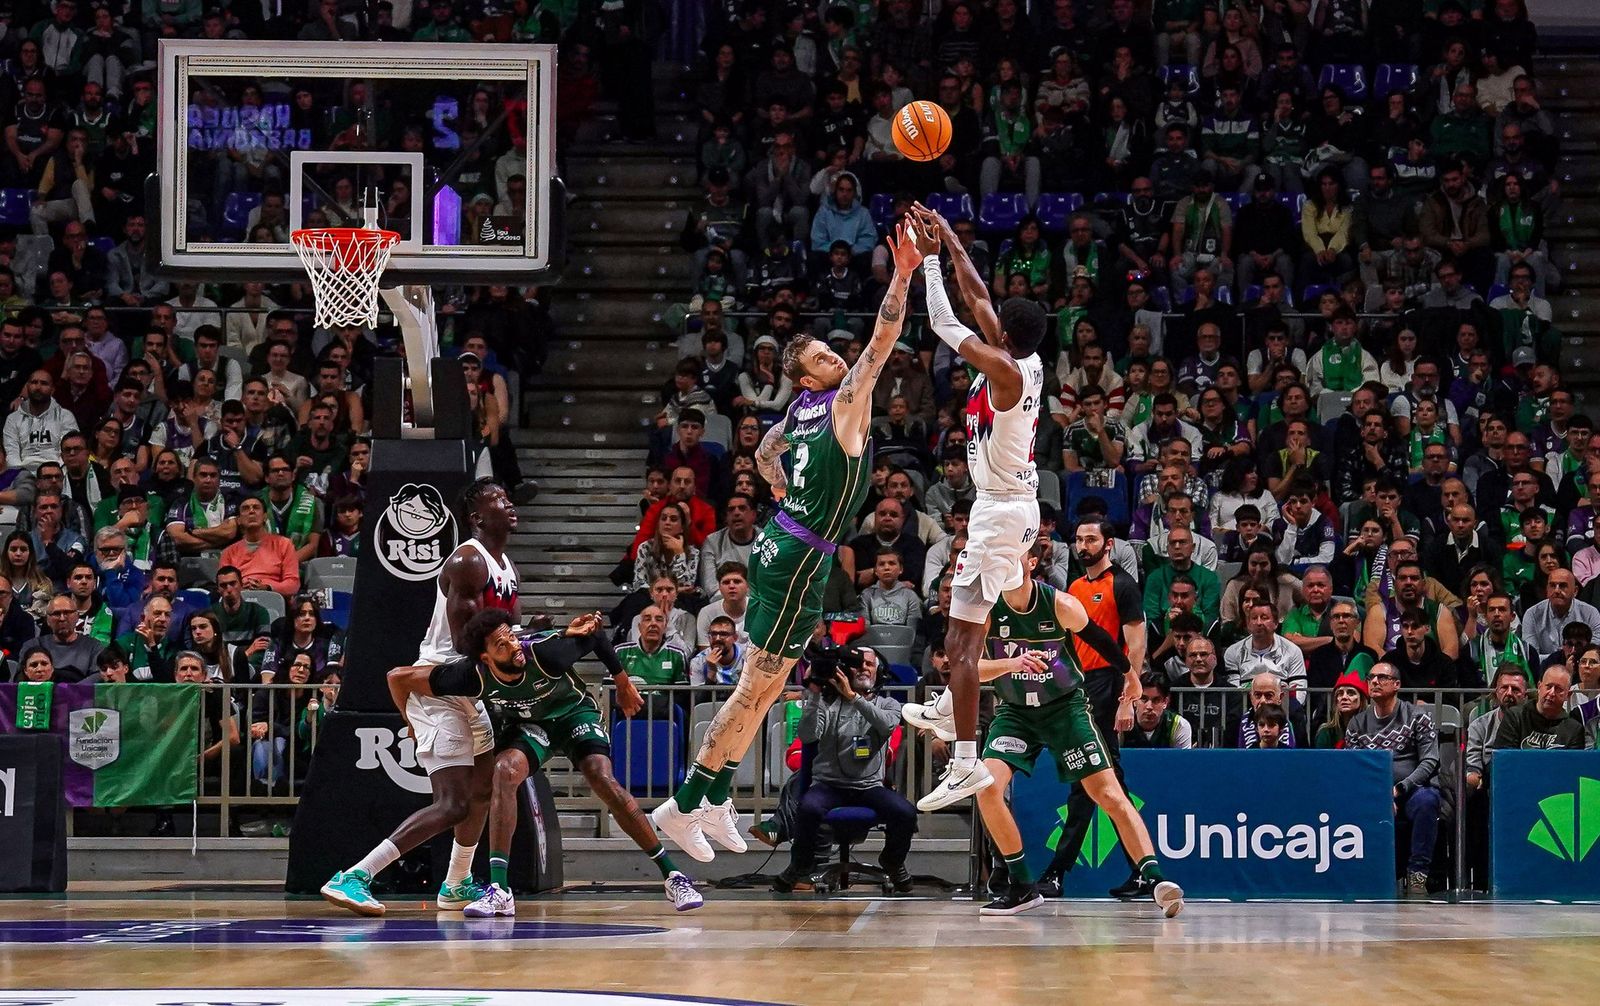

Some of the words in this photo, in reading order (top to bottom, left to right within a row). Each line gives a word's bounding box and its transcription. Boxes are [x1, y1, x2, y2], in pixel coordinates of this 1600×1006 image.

[29, 430, 52, 443] HH
[793, 442, 809, 489] 2
[387, 539, 444, 573] Risi
[81, 744, 108, 752] Unicaja
[1066, 757, 1087, 770] laga
[1157, 812, 1364, 873] Unicaja
